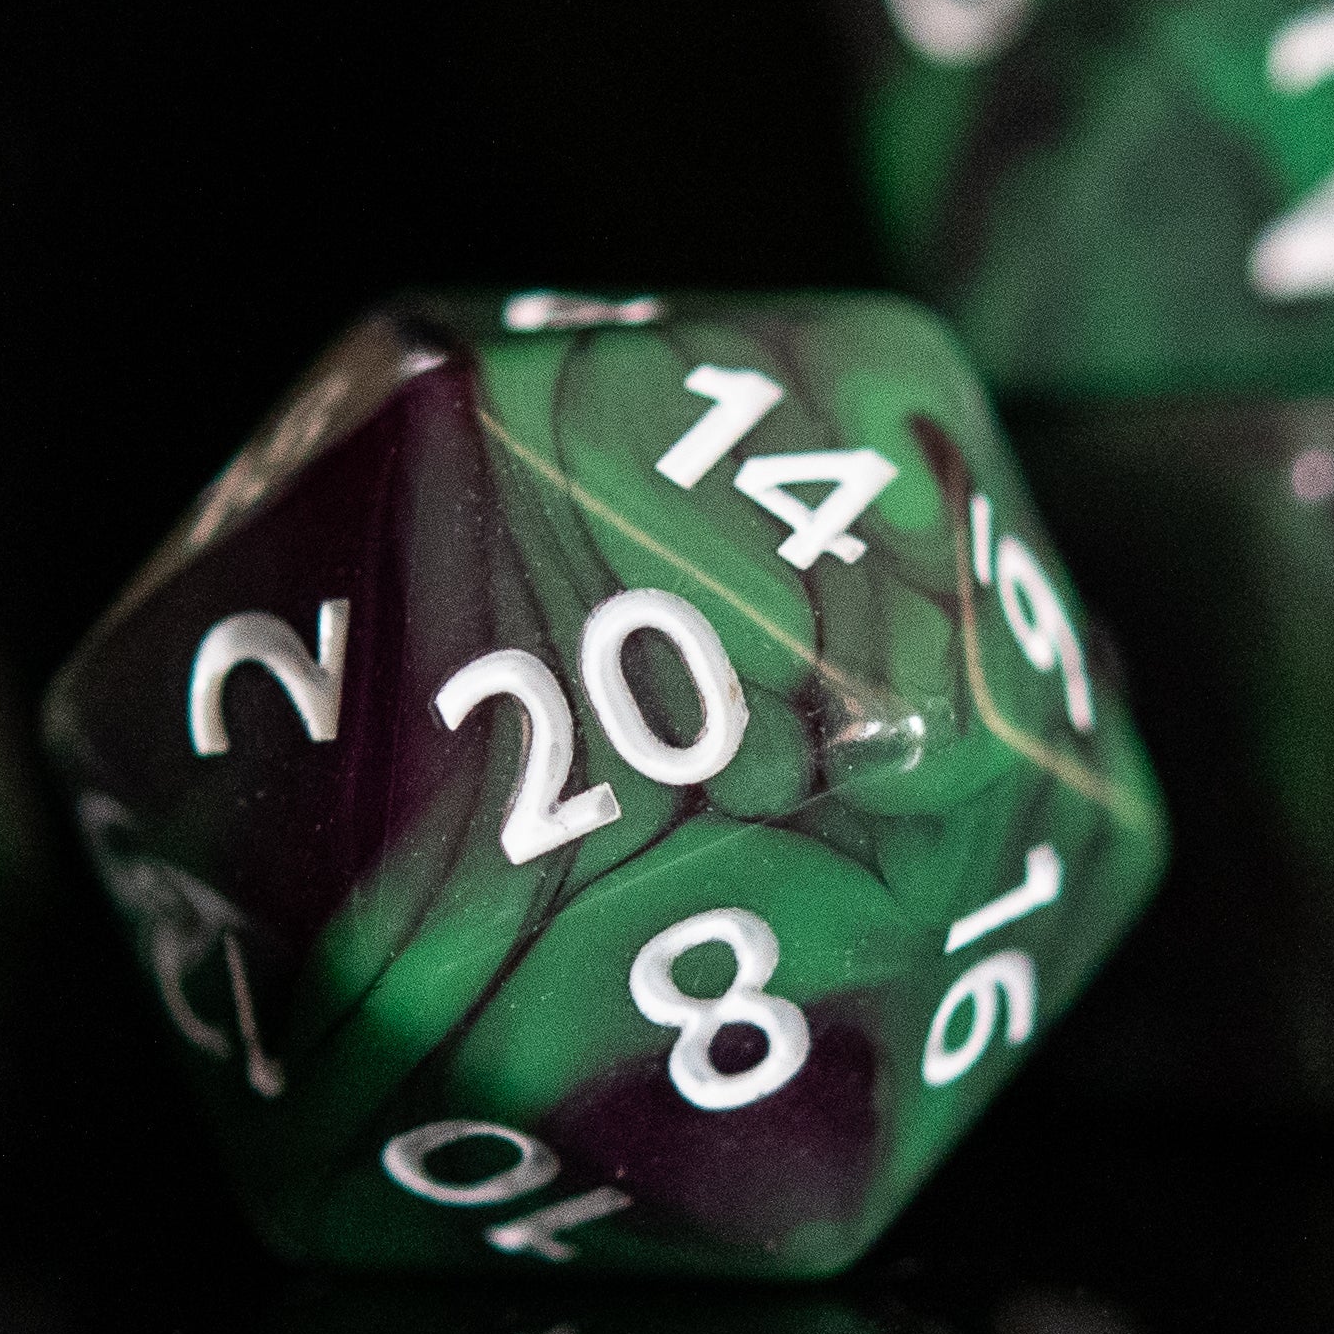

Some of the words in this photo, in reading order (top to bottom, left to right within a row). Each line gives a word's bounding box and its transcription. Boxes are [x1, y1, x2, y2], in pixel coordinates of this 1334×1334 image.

[655, 364, 899, 570] 14
[189, 600, 346, 756] 2
[434, 586, 751, 867] 20
[628, 907, 810, 1111] 8
[381, 1120, 627, 1259] 10
